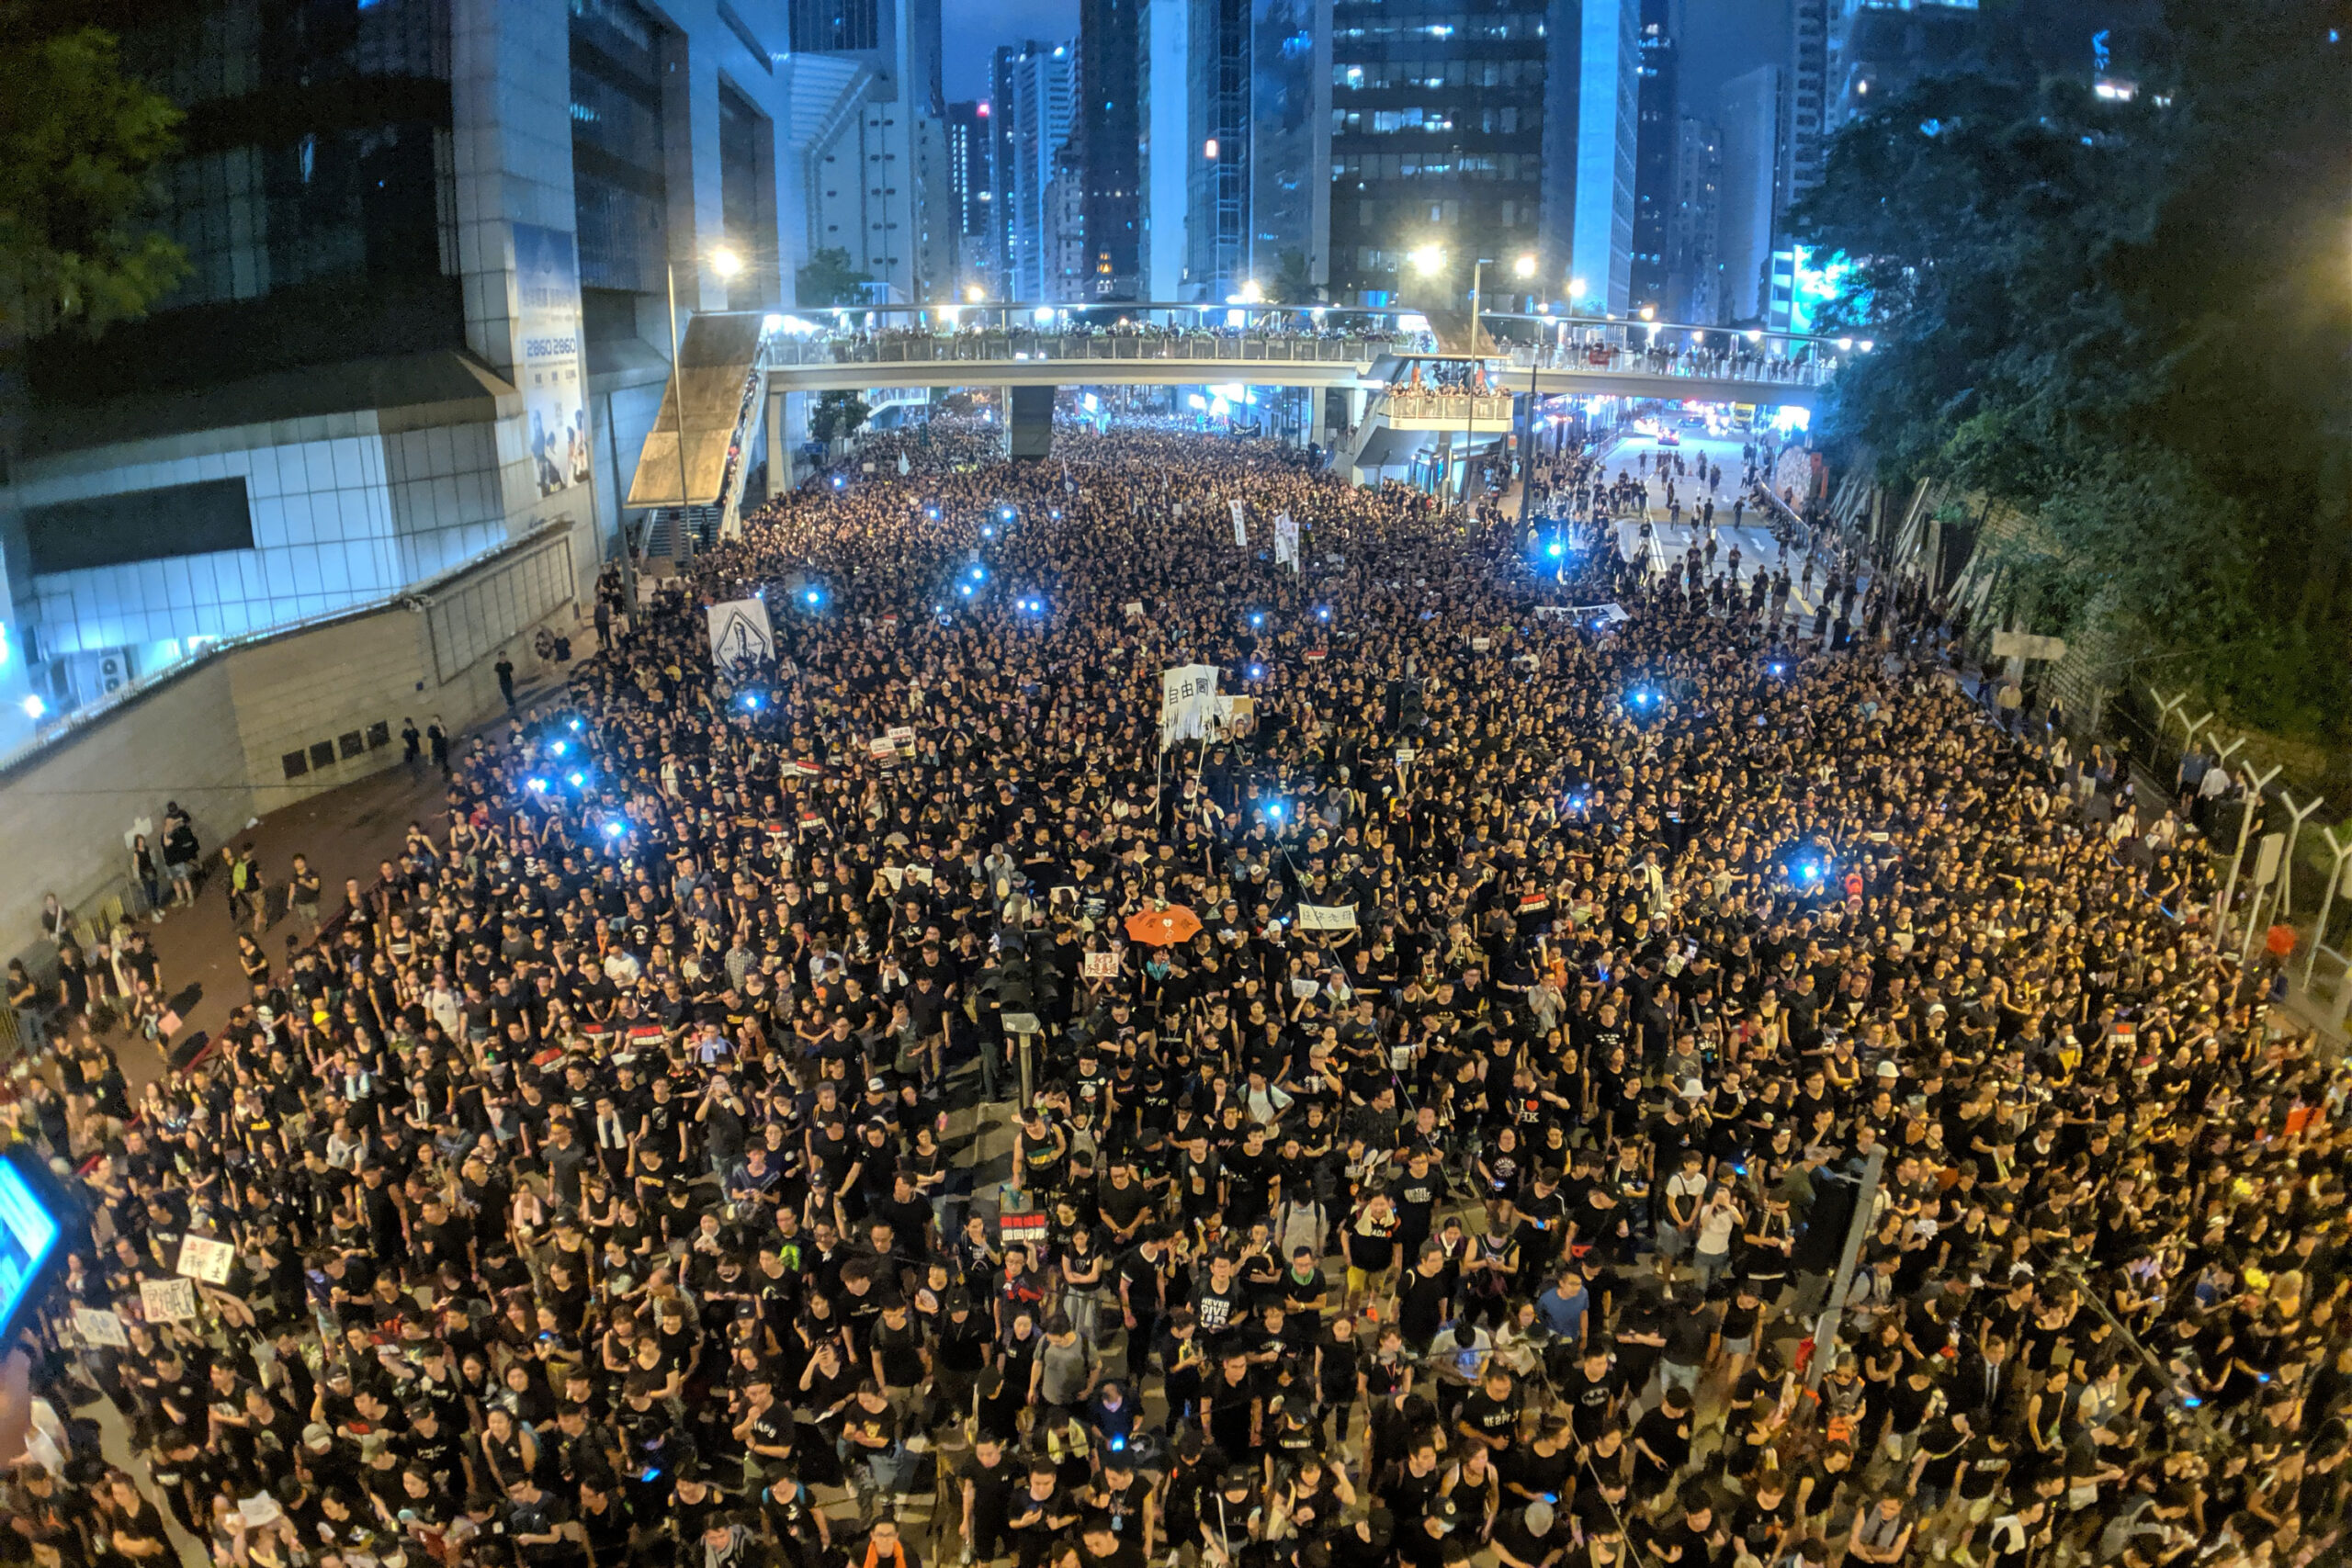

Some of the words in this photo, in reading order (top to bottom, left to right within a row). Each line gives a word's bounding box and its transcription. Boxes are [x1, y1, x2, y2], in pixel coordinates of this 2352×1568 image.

[526, 338, 552, 358] 2860
[553, 337, 577, 355] 2860
[1520, 1098, 1525, 1111] I
[1201, 1297, 1230, 1309] NEVER
[1200, 1304, 1229, 1317] GIVE
